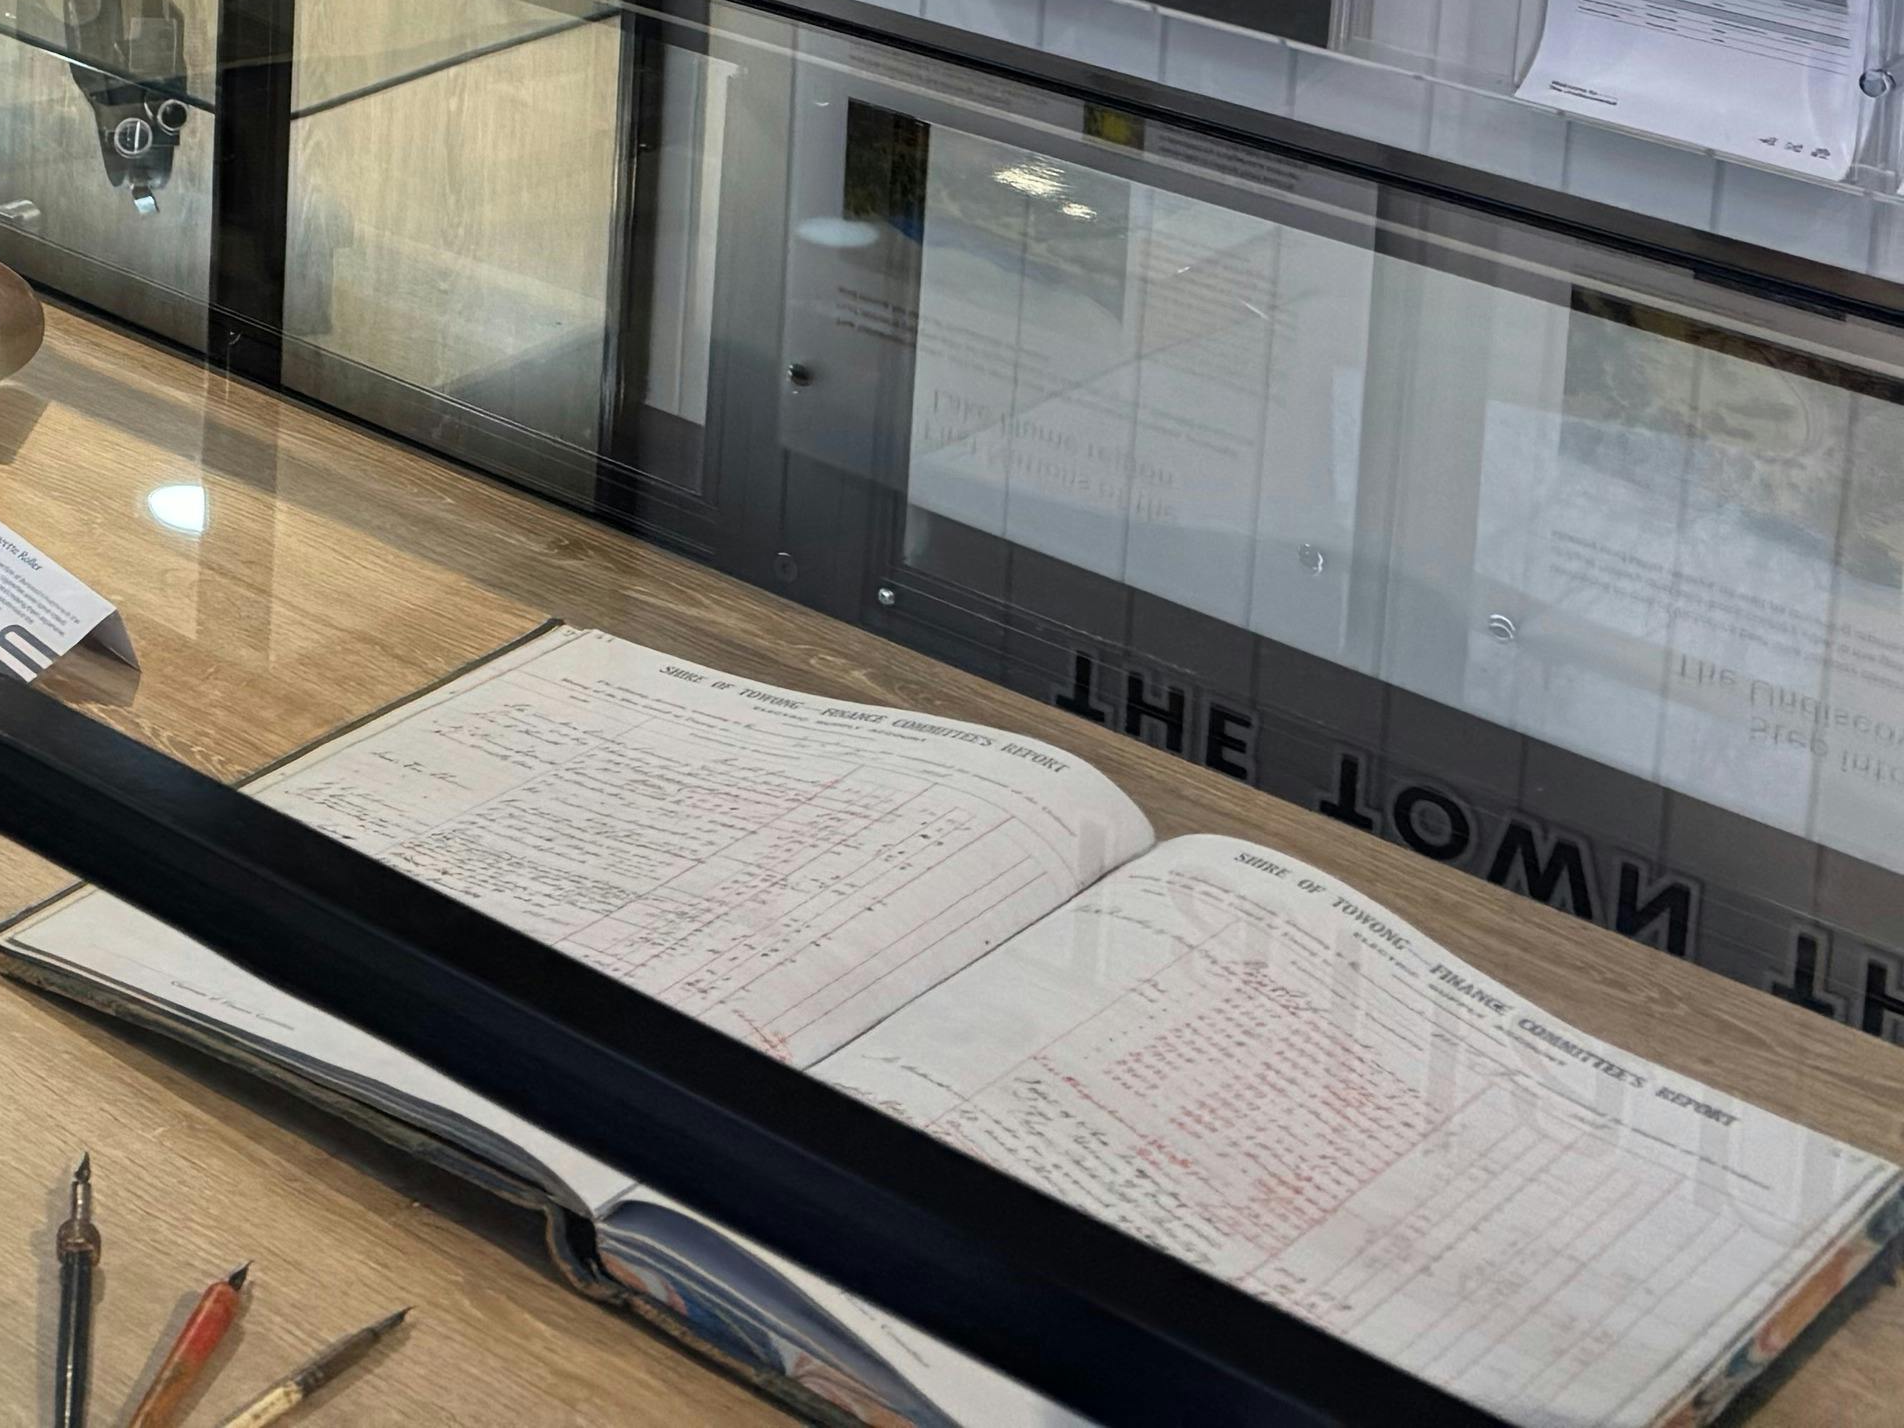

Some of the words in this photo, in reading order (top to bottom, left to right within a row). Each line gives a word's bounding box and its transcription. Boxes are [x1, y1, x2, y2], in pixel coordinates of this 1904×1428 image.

[659, 664, 706, 687] SHIRE
[711, 680, 732, 691] OF
[739, 687, 803, 711] TOWONG
[822, 707, 887, 723] FINANCE
[1001, 743, 1071, 774] REPORT
[1234, 851, 1291, 880] SHIRE
[1297, 877, 1327, 895] OF
[1332, 896, 1411, 950] TOWONG
[1429, 962, 1513, 1016] FINANCE
[1519, 1018, 1647, 1089] COMMITTEE'S
[1655, 1086, 1741, 1129] REPORT
